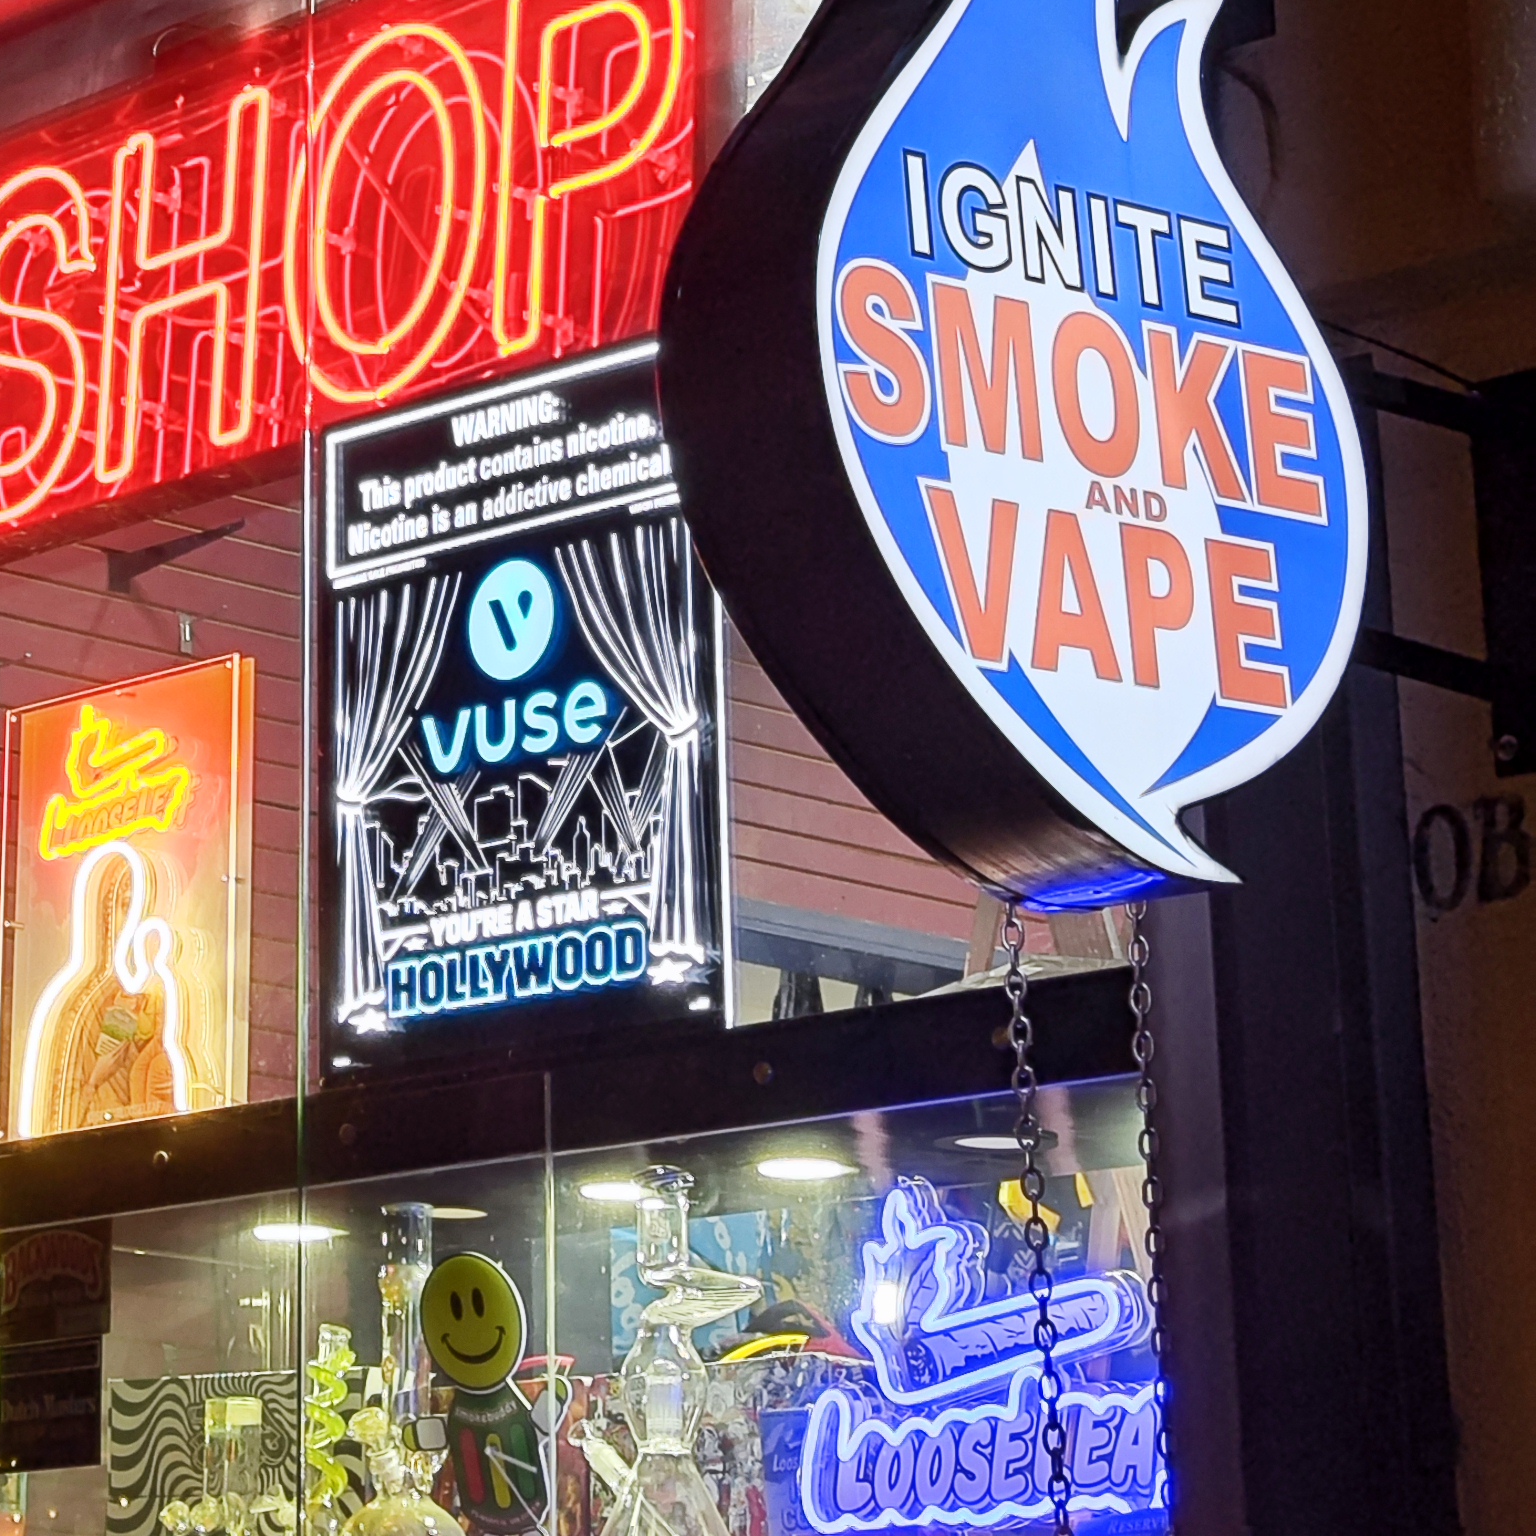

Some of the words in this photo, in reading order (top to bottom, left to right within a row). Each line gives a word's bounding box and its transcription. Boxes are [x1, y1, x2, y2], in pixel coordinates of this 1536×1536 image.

[902, 148, 1242, 328] IGNITE
[451, 391, 561, 448] WARNING:
[835, 259, 1330, 526] SMOKE
[358, 475, 402, 513] This
[404, 457, 477, 510] product
[479, 436, 564, 482] contains
[566, 412, 657, 458] nicotine.
[1085, 479, 1169, 523] AND
[347, 513, 429, 557] Nicotine
[431, 503, 451, 535] is
[454, 502, 478, 530] an
[482, 476, 572, 522] addictive
[919, 476, 1294, 711] VAPE
[427, 903, 514, 948] YOU'RE
[514, 899, 536, 932] A
[536, 888, 600, 930] STAR
[386, 920, 647, 1018] HOLLYWOOD
